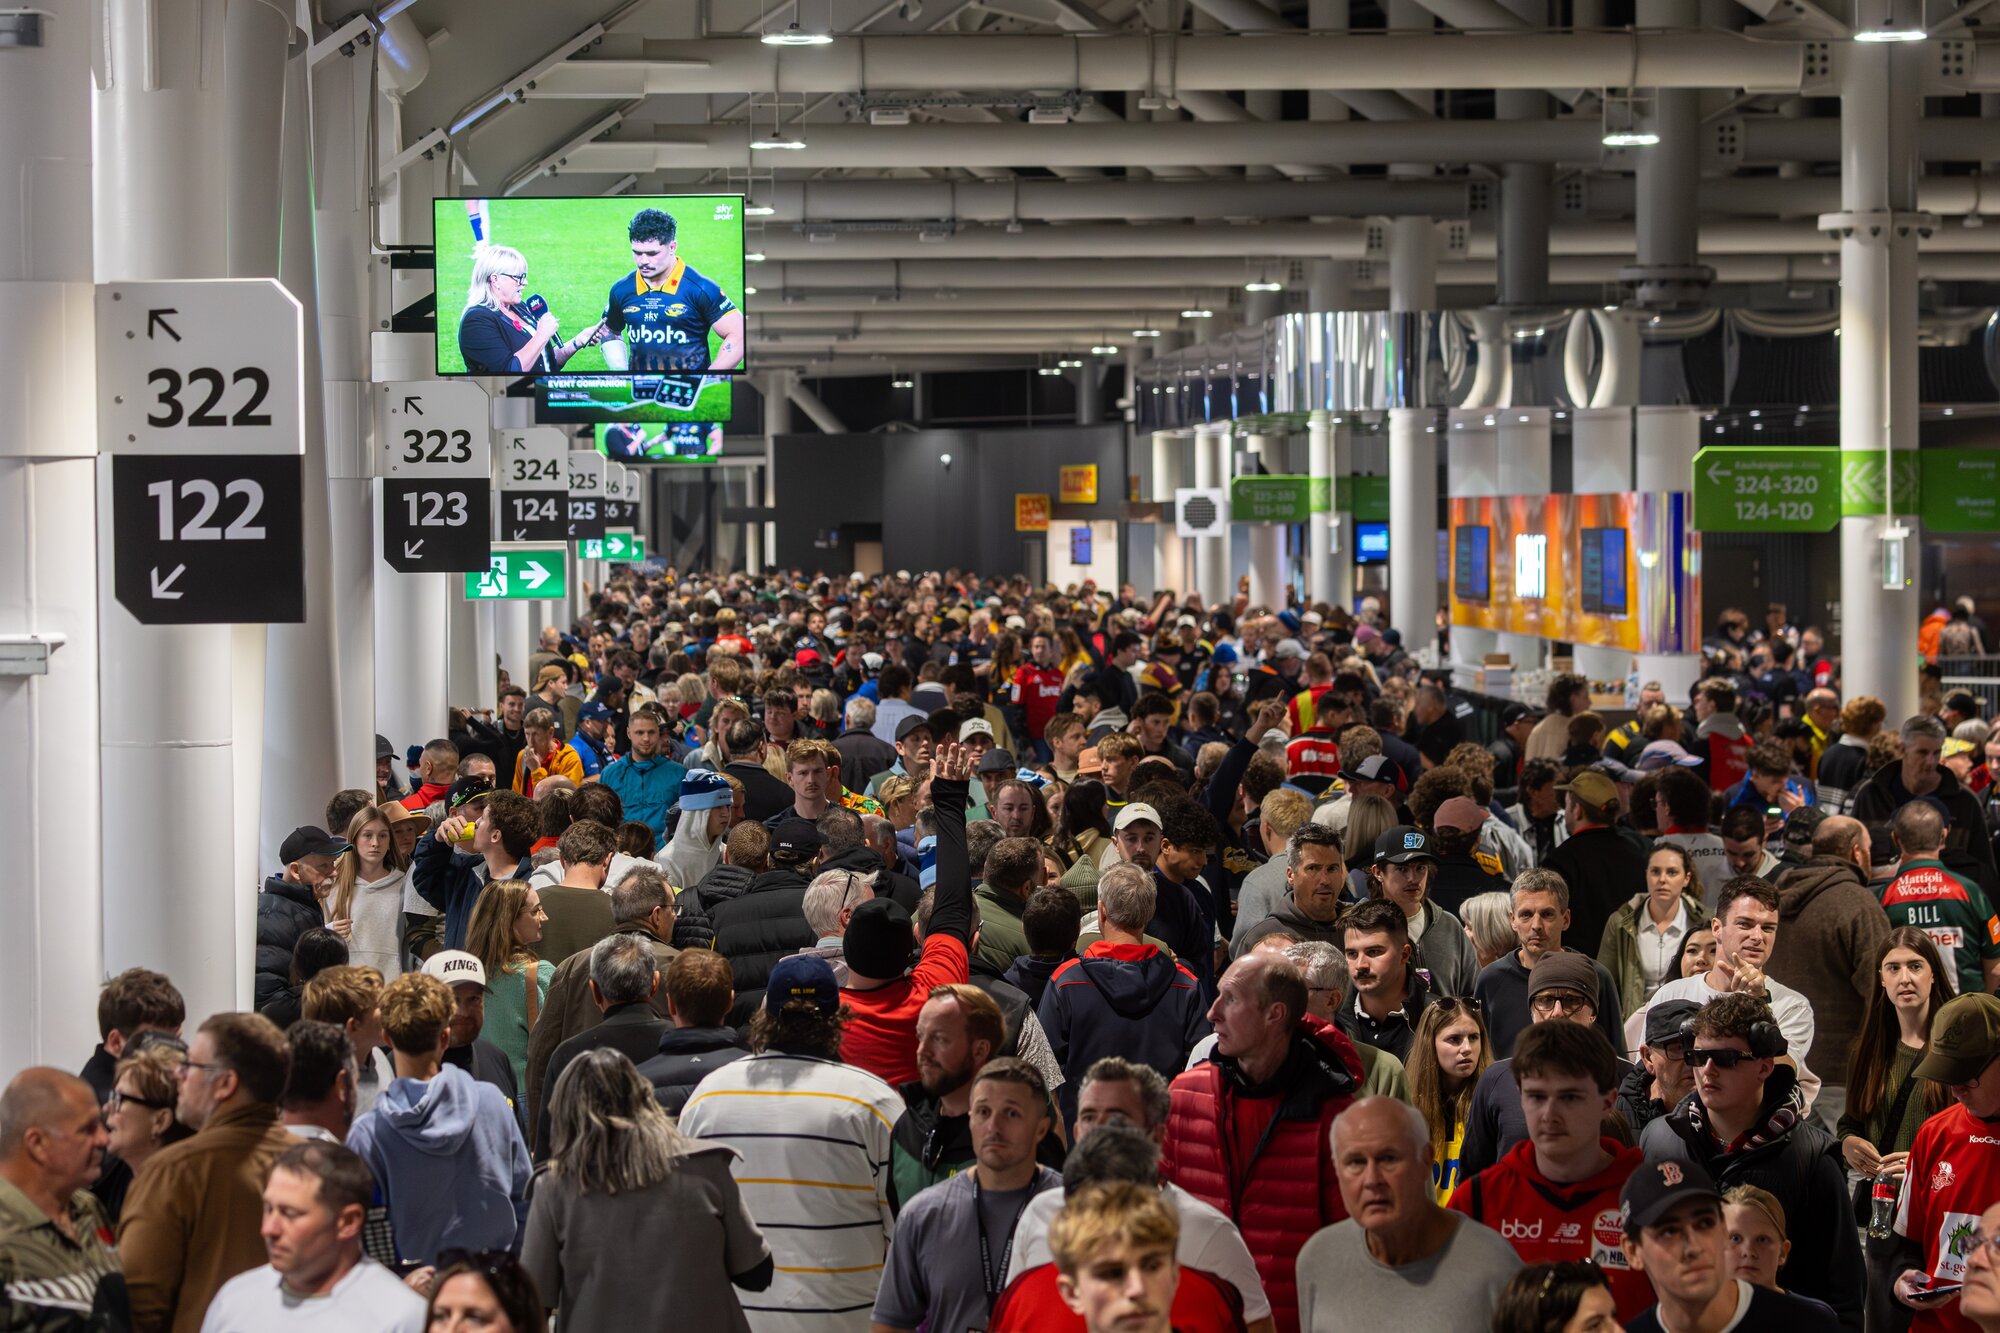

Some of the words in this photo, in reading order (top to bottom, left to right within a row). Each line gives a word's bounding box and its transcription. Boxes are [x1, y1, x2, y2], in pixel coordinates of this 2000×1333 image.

[716, 204, 732, 215] sky
[548, 380, 576, 388] EVENT
[577, 380, 626, 388] COMPANION
[147, 366, 272, 428] 322
[403, 429, 472, 463] 323
[512, 459, 560, 481] 324
[1734, 475, 1819, 494] 324-320
[148, 478, 266, 541] 122
[403, 491, 468, 527] 123
[513, 498, 559, 521] 124
[1734, 502, 1814, 521] 124-120
[1404, 833, 1425, 849] 97
[1897, 872, 1943, 888] Mattioli
[1897, 882, 1938, 897] Woods
[1938, 885, 1951, 895] plc
[1908, 905, 1941, 925] BILL
[443, 959, 478, 973] KINGS
[1657, 1160, 1684, 1187] B
[1501, 1218, 1542, 1239] bbd
